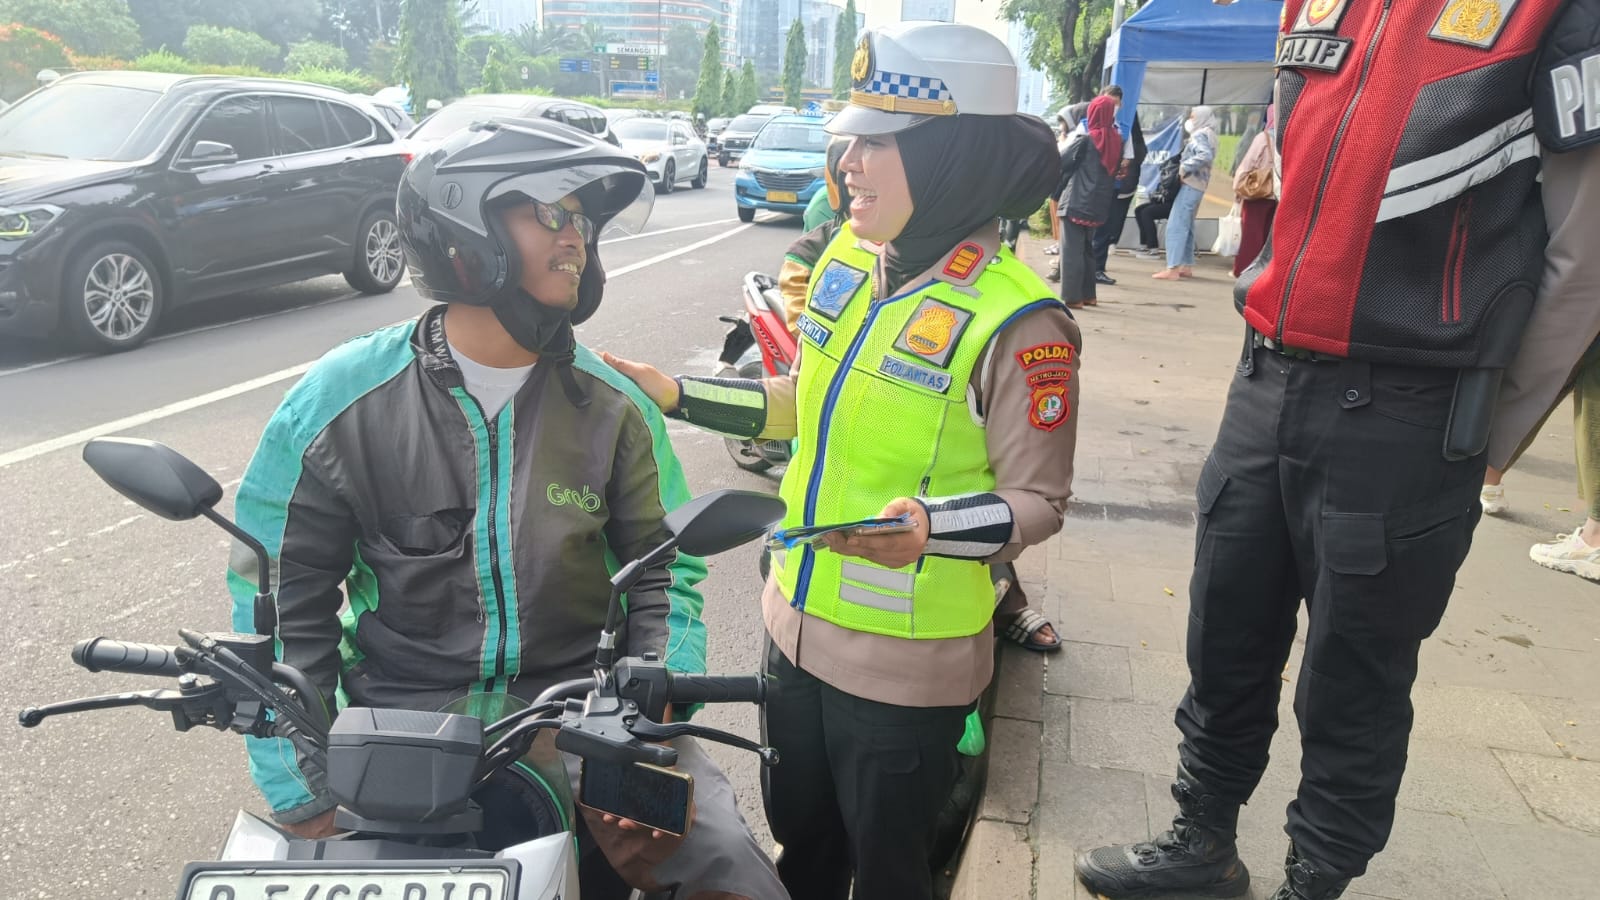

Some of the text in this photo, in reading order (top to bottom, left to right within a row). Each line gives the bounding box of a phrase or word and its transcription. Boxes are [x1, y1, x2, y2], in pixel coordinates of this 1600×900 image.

[1280, 39, 1340, 64] ALIF
[1022, 346, 1069, 365] POLDA
[547, 483, 600, 512] Grab
